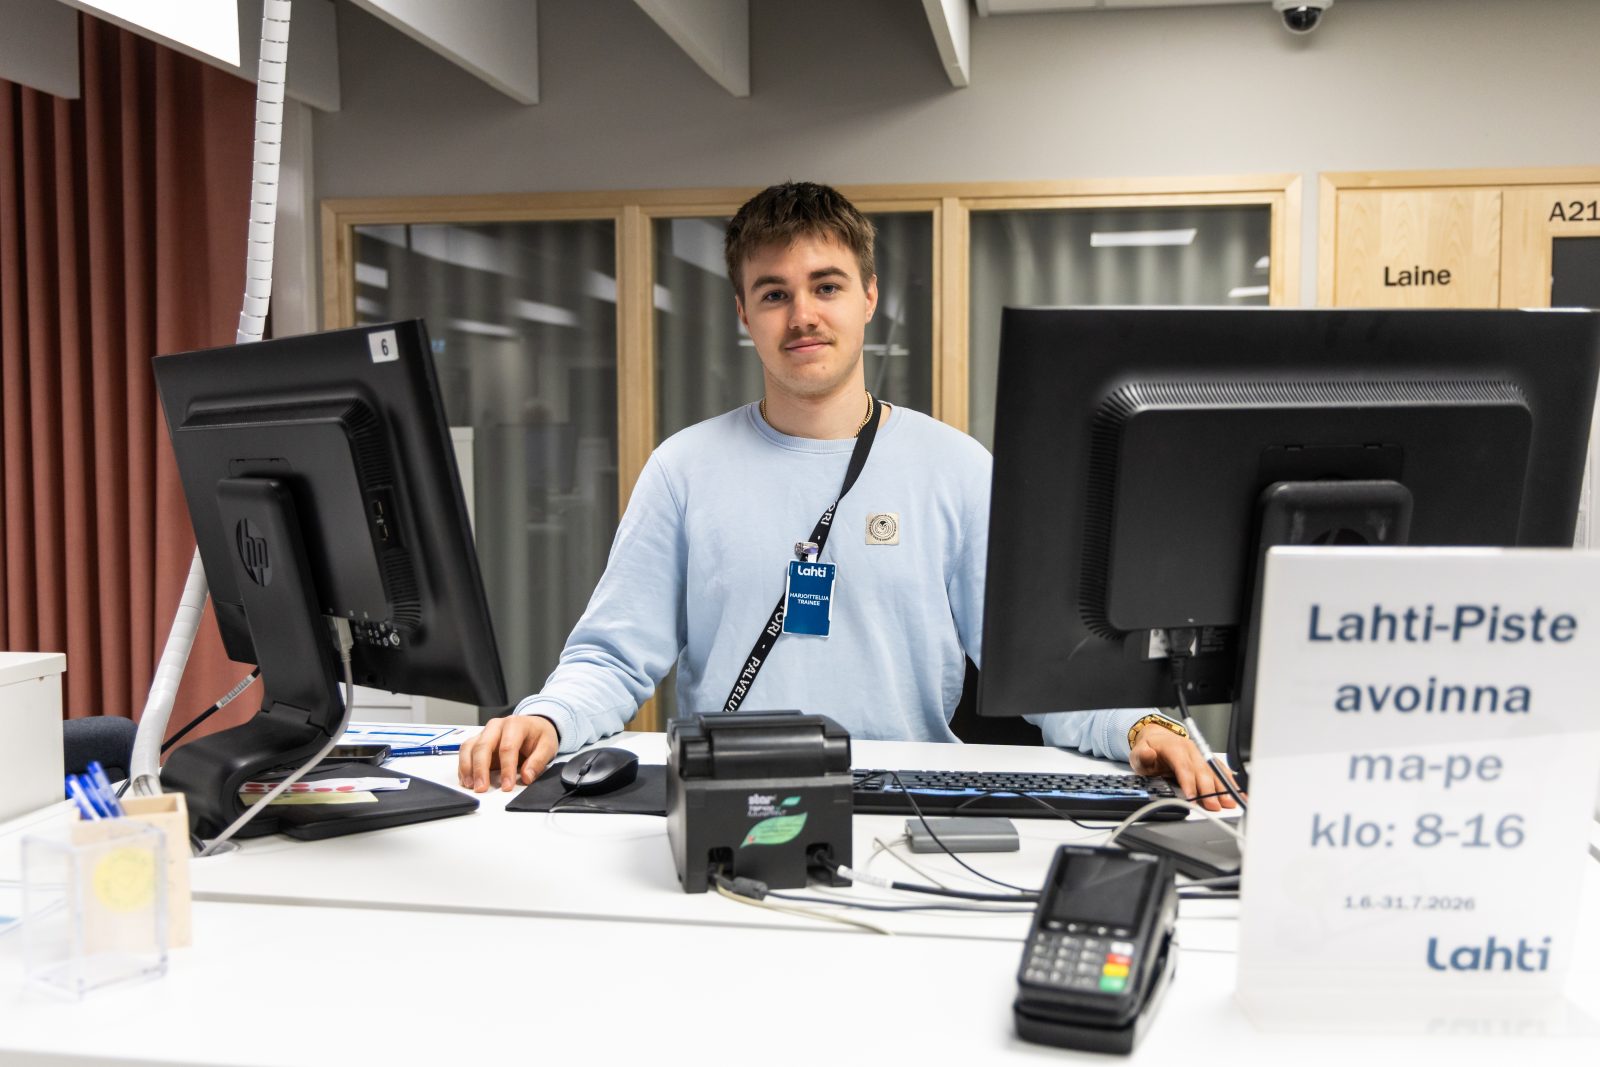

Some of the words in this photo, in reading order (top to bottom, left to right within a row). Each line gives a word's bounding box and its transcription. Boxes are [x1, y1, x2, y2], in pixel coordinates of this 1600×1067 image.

[1383, 265, 1452, 287] Laine
[380, 338, 389, 357] 6
[797, 564, 827, 578] Lahti
[797, 598, 821, 607] TRAINEE
[1307, 604, 1578, 643] Lahti-Piste
[1334, 676, 1532, 714] avoinna
[1348, 753, 1504, 790] ma-pe
[1310, 812, 1395, 849] klo:
[1412, 813, 1526, 849] 8-16
[1343, 895, 1477, 911] 1.6.-31.7.2026
[1426, 936, 1552, 973] Lahti
